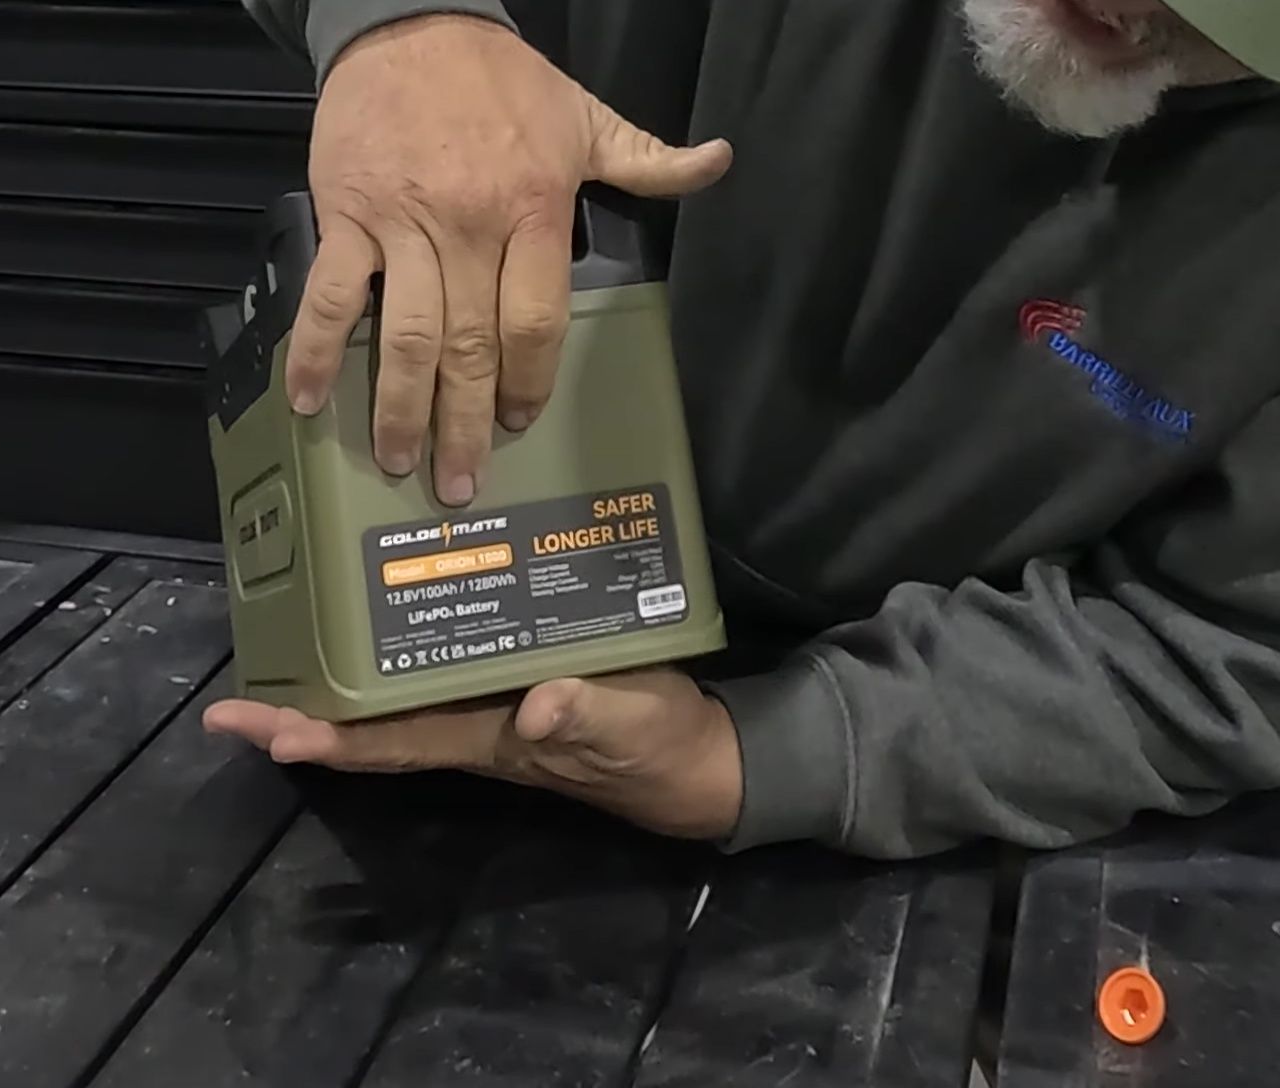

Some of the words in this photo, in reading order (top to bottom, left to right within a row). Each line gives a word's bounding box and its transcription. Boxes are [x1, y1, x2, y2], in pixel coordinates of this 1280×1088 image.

[593, 493, 656, 519] SAFER
[533, 525, 615, 555] LONGER
[619, 517, 660, 540] LIFE
[456, 600, 500, 618] Battery
